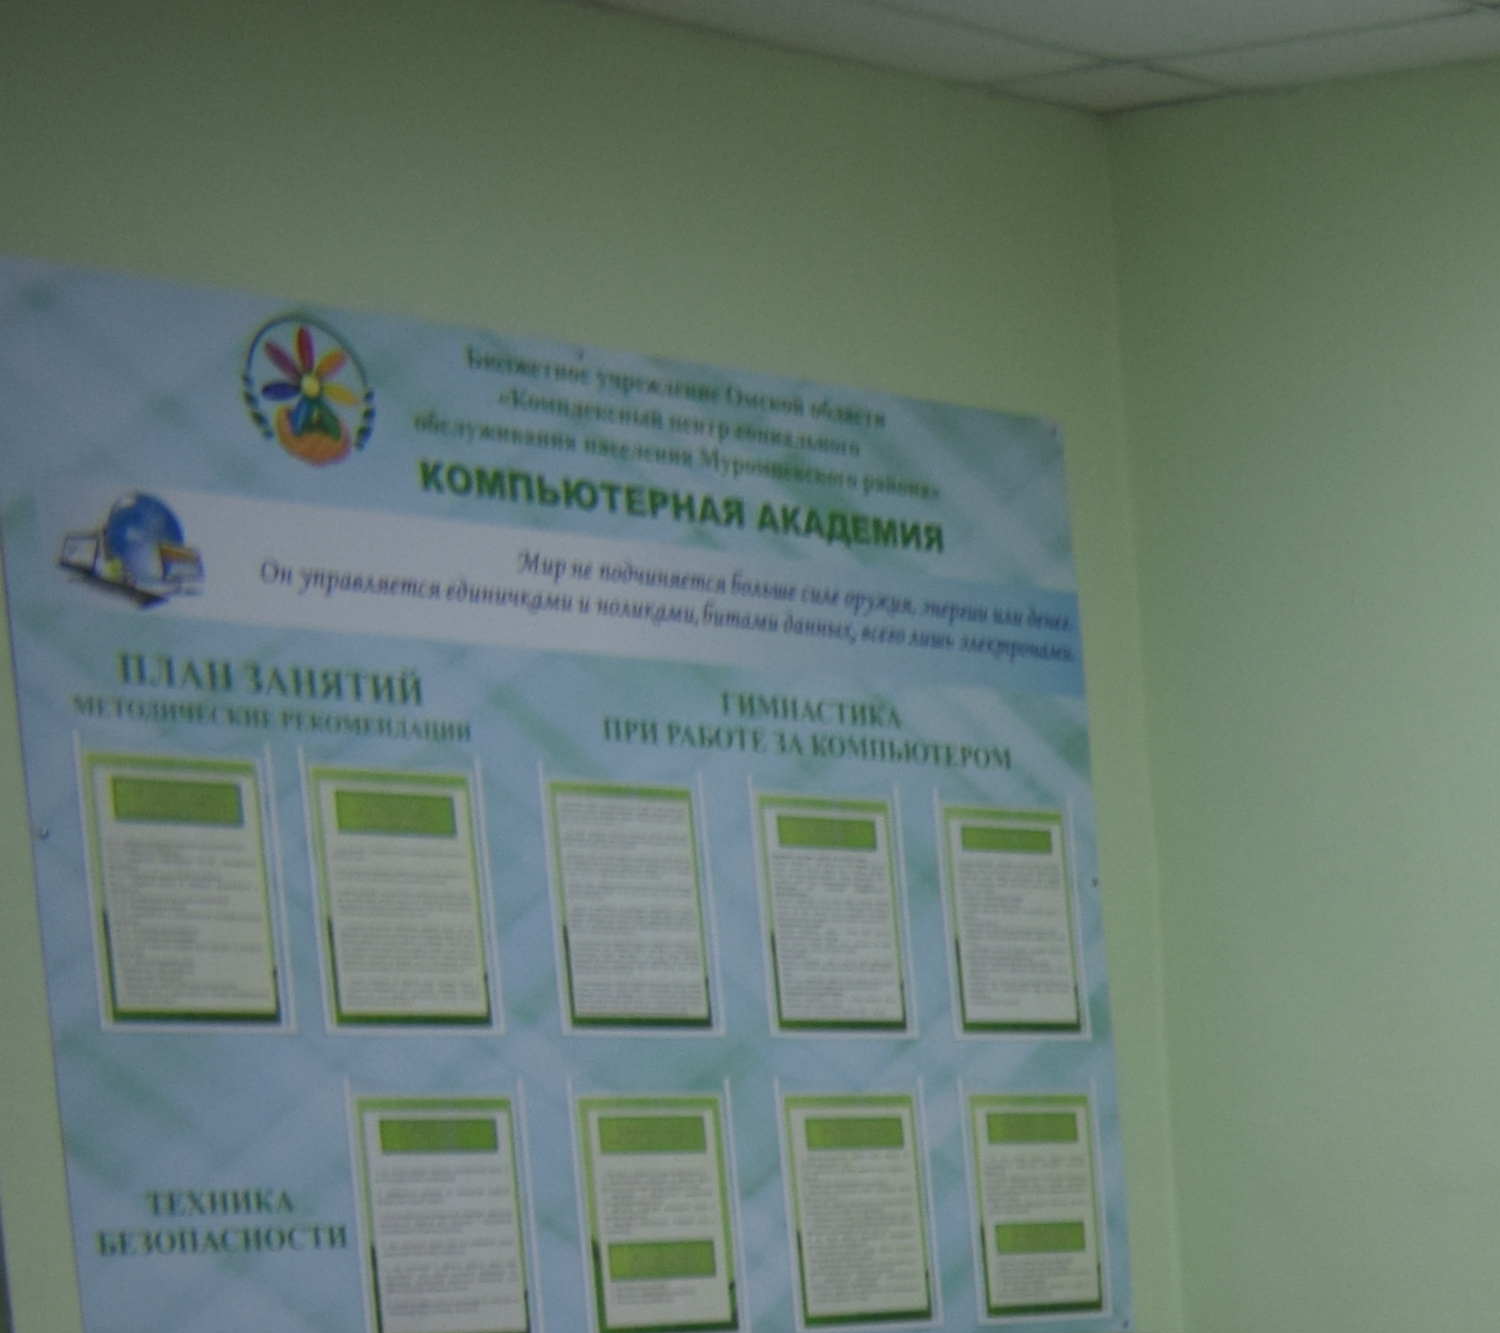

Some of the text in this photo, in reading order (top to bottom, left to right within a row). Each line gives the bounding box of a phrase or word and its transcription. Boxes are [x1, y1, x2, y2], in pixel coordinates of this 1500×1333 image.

[418, 457, 947, 555] КОМПЬЮТЕРНАЯ АКАДЕМИЯ
[259, 561, 292, 587] Он
[297, 567, 440, 600] управляется
[445, 581, 573, 615] единичками
[703, 602, 778, 634] битами
[517, 549, 566, 584] Мир
[571, 560, 593, 582] не
[598, 561, 726, 597] подчиняется
[731, 571, 797, 603] больше
[117, 650, 425, 708] ПЛАН ЗАНЯТИЙ
[71, 694, 473, 744] МЕТОДИЧЕСКИЕ РЕКОМЕНДАЦИИ
[720, 690, 902, 730] ГИМНАСТИКА
[602, 715, 1013, 773] ПРИ РАБОТЕ ЗА КОМПЬЮТЕРОМ
[145, 1187, 295, 1218] ТЕХНИКА
[95, 1222, 349, 1258] БЕЗОПАСНОСТИ
